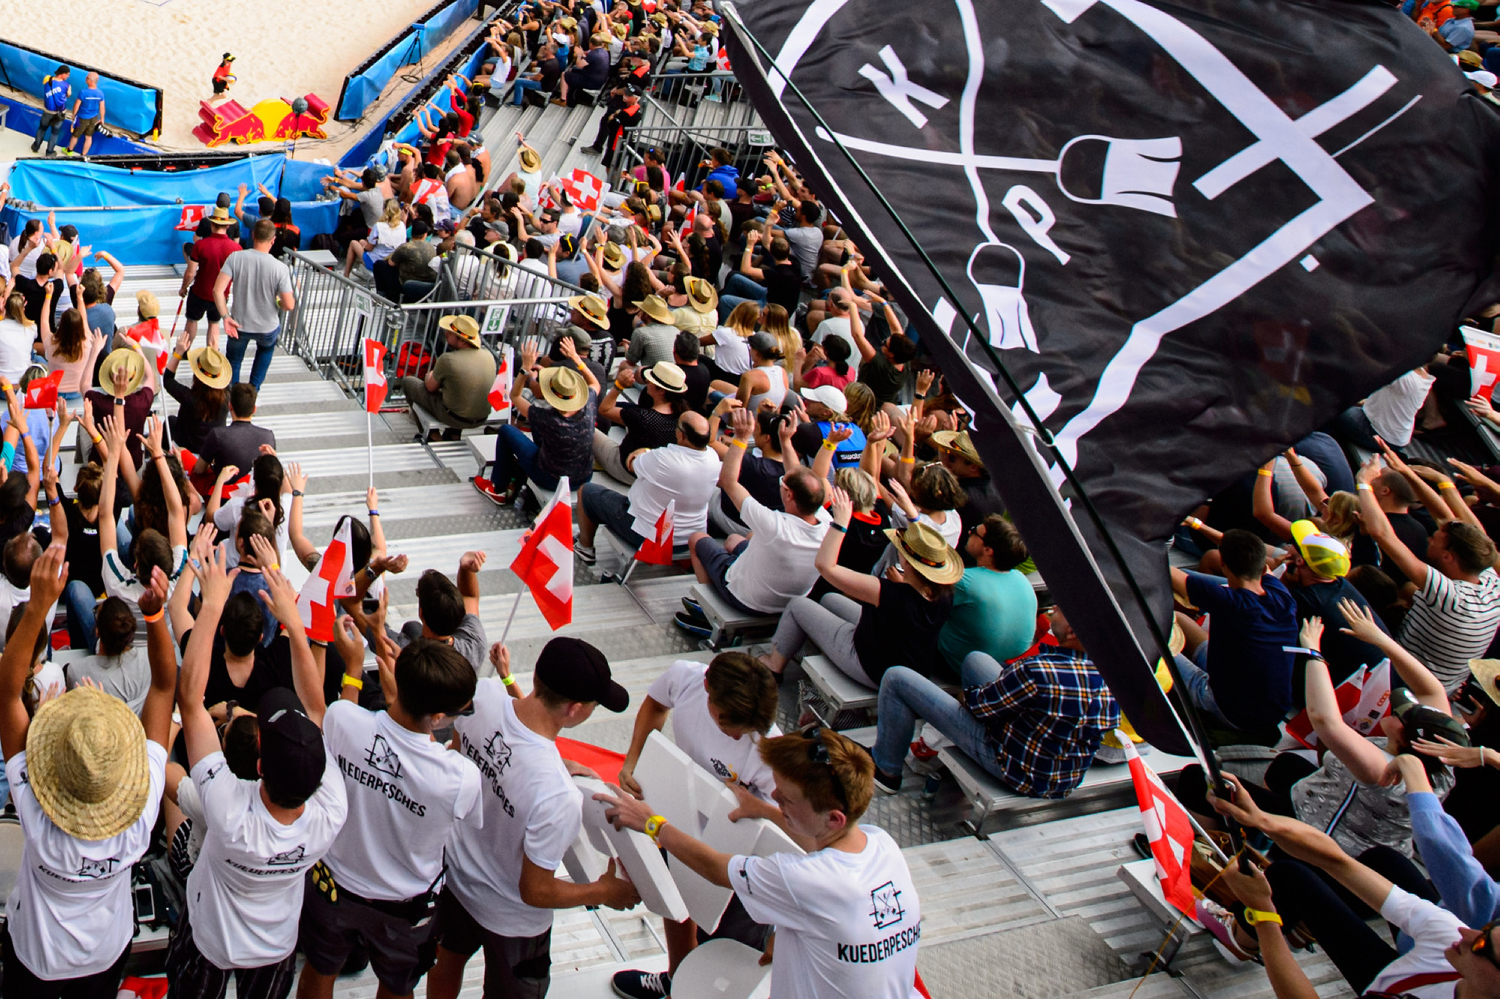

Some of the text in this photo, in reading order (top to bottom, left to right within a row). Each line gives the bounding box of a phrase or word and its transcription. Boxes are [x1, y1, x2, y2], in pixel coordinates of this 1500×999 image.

[858, 44, 949, 129] K
[1001, 185, 1072, 265] P
[837, 920, 921, 964] KUEDERPESCHE
